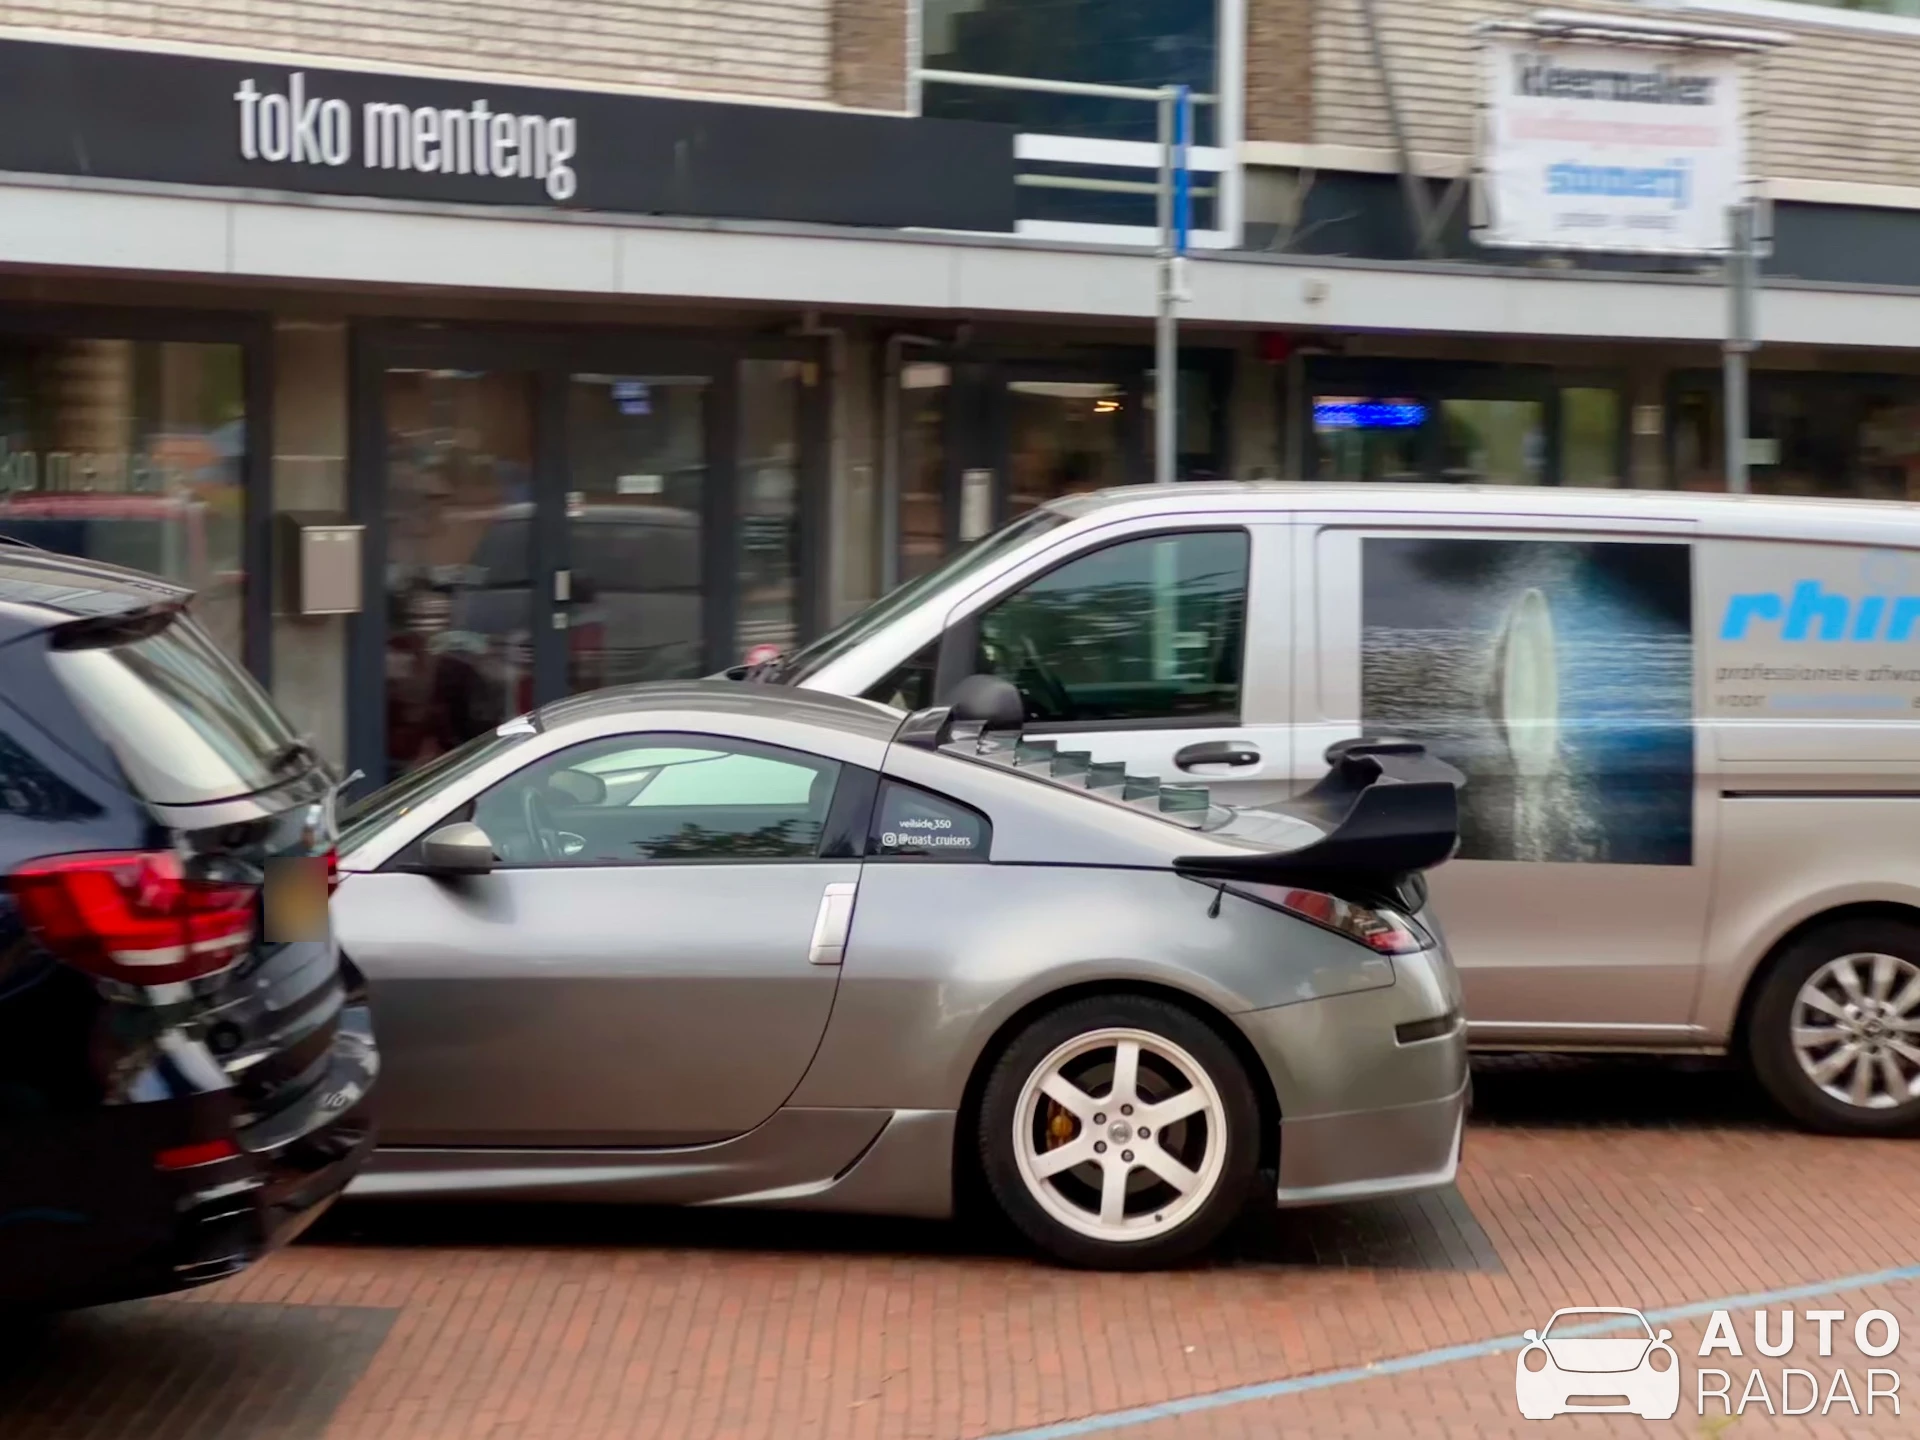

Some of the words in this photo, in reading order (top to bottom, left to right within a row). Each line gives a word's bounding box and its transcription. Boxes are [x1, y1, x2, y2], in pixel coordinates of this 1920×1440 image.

[233, 71, 352, 167] toko
[362, 98, 577, 201] menteng
[899, 819, 951, 829] veilside_350
